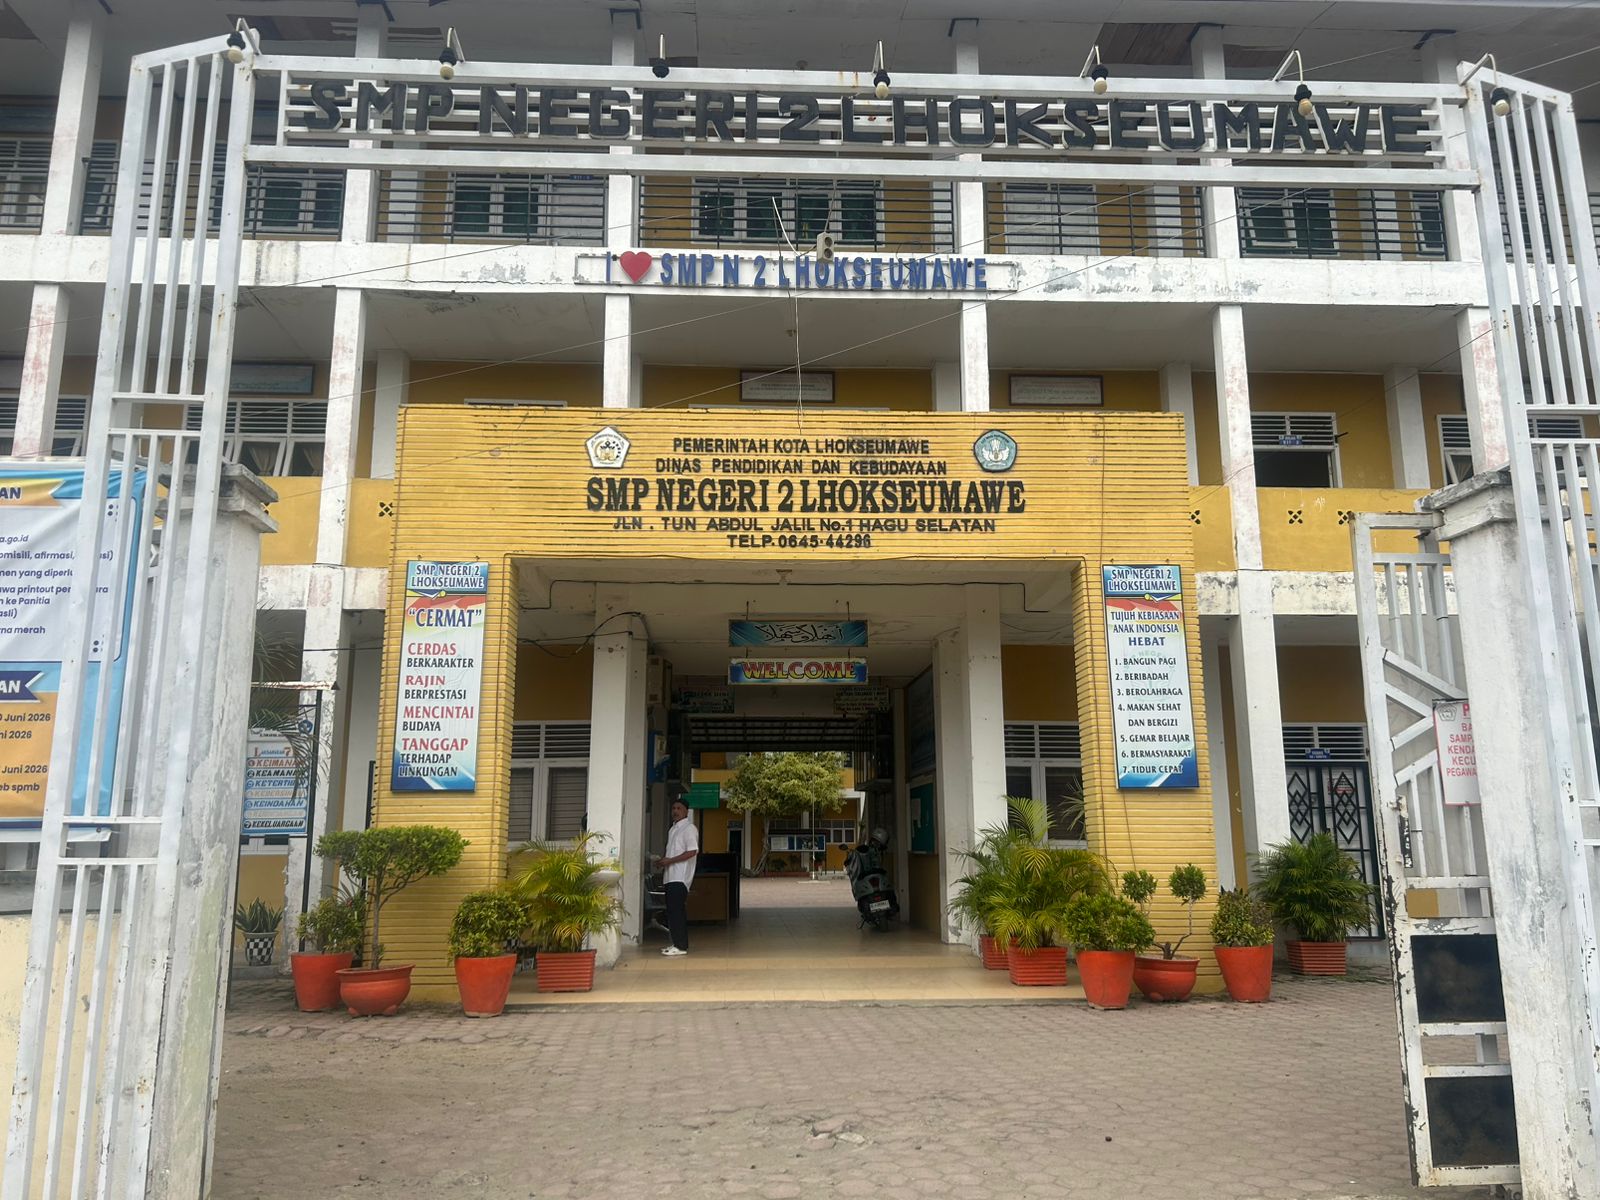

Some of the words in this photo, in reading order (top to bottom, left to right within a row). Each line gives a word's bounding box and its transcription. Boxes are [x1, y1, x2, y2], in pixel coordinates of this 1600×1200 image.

[307, 79, 454, 134] SMP
[480, 84, 758, 142] NEGERI
[778, 96, 820, 143] 2
[842, 96, 1429, 155] LHOKSEUMAWE
[606, 251, 612, 283] I
[753, 255, 767, 287] 2
[778, 255, 987, 291] LHOKSEUMAWE
[673, 438, 768, 453] PEMERINTAH
[774, 439, 809, 454] KOTA
[816, 439, 929, 454] LHOKSEUMAWE
[656, 458, 701, 472] DINAS
[712, 459, 802, 474] PENDIDIKAN
[812, 460, 840, 474] DAN
[849, 460, 947, 475] KEBUDAYAAN
[587, 477, 649, 511] SMP
[656, 478, 769, 512] NEGERI
[778, 479, 794, 512] 2
[800, 480, 1026, 513] LHOKSEUMAWE
[661, 517, 696, 530] TUN
[706, 517, 763, 531] ABDUL
[771, 518, 815, 531] JALIL
[859, 519, 909, 532] HAGU
[915, 519, 995, 532] SELATAN
[34, 551, 75, 560] afirmasi,
[19, 569, 42, 579] yang
[416, 564, 435, 575] SMP
[440, 565, 471, 576] NEGERI
[474, 565, 480, 576] 2
[1111, 569, 1130, 579] SMP
[1133, 569, 1164, 579] NEGERI
[1167, 569, 1172, 579] 2
[411, 576, 484, 588] LHOKSEUMAWE
[1108, 581, 1177, 591] LHOKSEUMAWE
[17, 584, 55, 595] printout
[5, 597, 17, 605] ke
[18, 597, 51, 605] Panitia
[1110, 611, 1136, 622] TUJUH
[1138, 611, 1179, 620] KEBIASAAN
[14, 625, 46, 634] merah
[1113, 624, 1134, 633] ANAK
[1136, 624, 1179, 633] INDONESIA
[1128, 637, 1165, 646] HEBAT
[408, 643, 456, 655] CERDAS
[406, 658, 474, 668] BERKARAKTER
[1123, 658, 1157, 666] BANGUN
[1159, 657, 1177, 665] PAGI
[743, 661, 856, 680] WELCOME
[405, 675, 446, 688] RAJIN
[1115, 673, 1123, 681] 2.
[1124, 673, 1169, 681] BERIBADAH
[404, 689, 467, 700] BERPRESTASI
[1125, 688, 1183, 696] BEROLAHRAGA
[1127, 703, 1155, 711] MAKAN
[1157, 703, 1181, 711] SEHAT
[4, 713, 26, 722] Juni
[28, 713, 51, 722] 2026
[403, 706, 474, 719] MENCINTAI
[402, 721, 441, 731] BUDAYA
[1128, 719, 1145, 727] DAN
[1147, 718, 1178, 727] BERGIZI
[9, 730, 32, 739] 2026
[1129, 734, 1157, 742] GEMAR
[1158, 734, 1190, 743] BELAJAR
[1449, 734, 1473, 743] SAMP
[402, 738, 469, 751] TANGGAP
[400, 753, 452, 764] TERHADAP
[1130, 750, 1191, 758] BERMASYARAKAT
[2, 765, 23, 774] Juni
[25, 765, 48, 773] 2026
[1158, 765, 1183, 773] CEPAT
[11, 783, 40, 793] spmb
